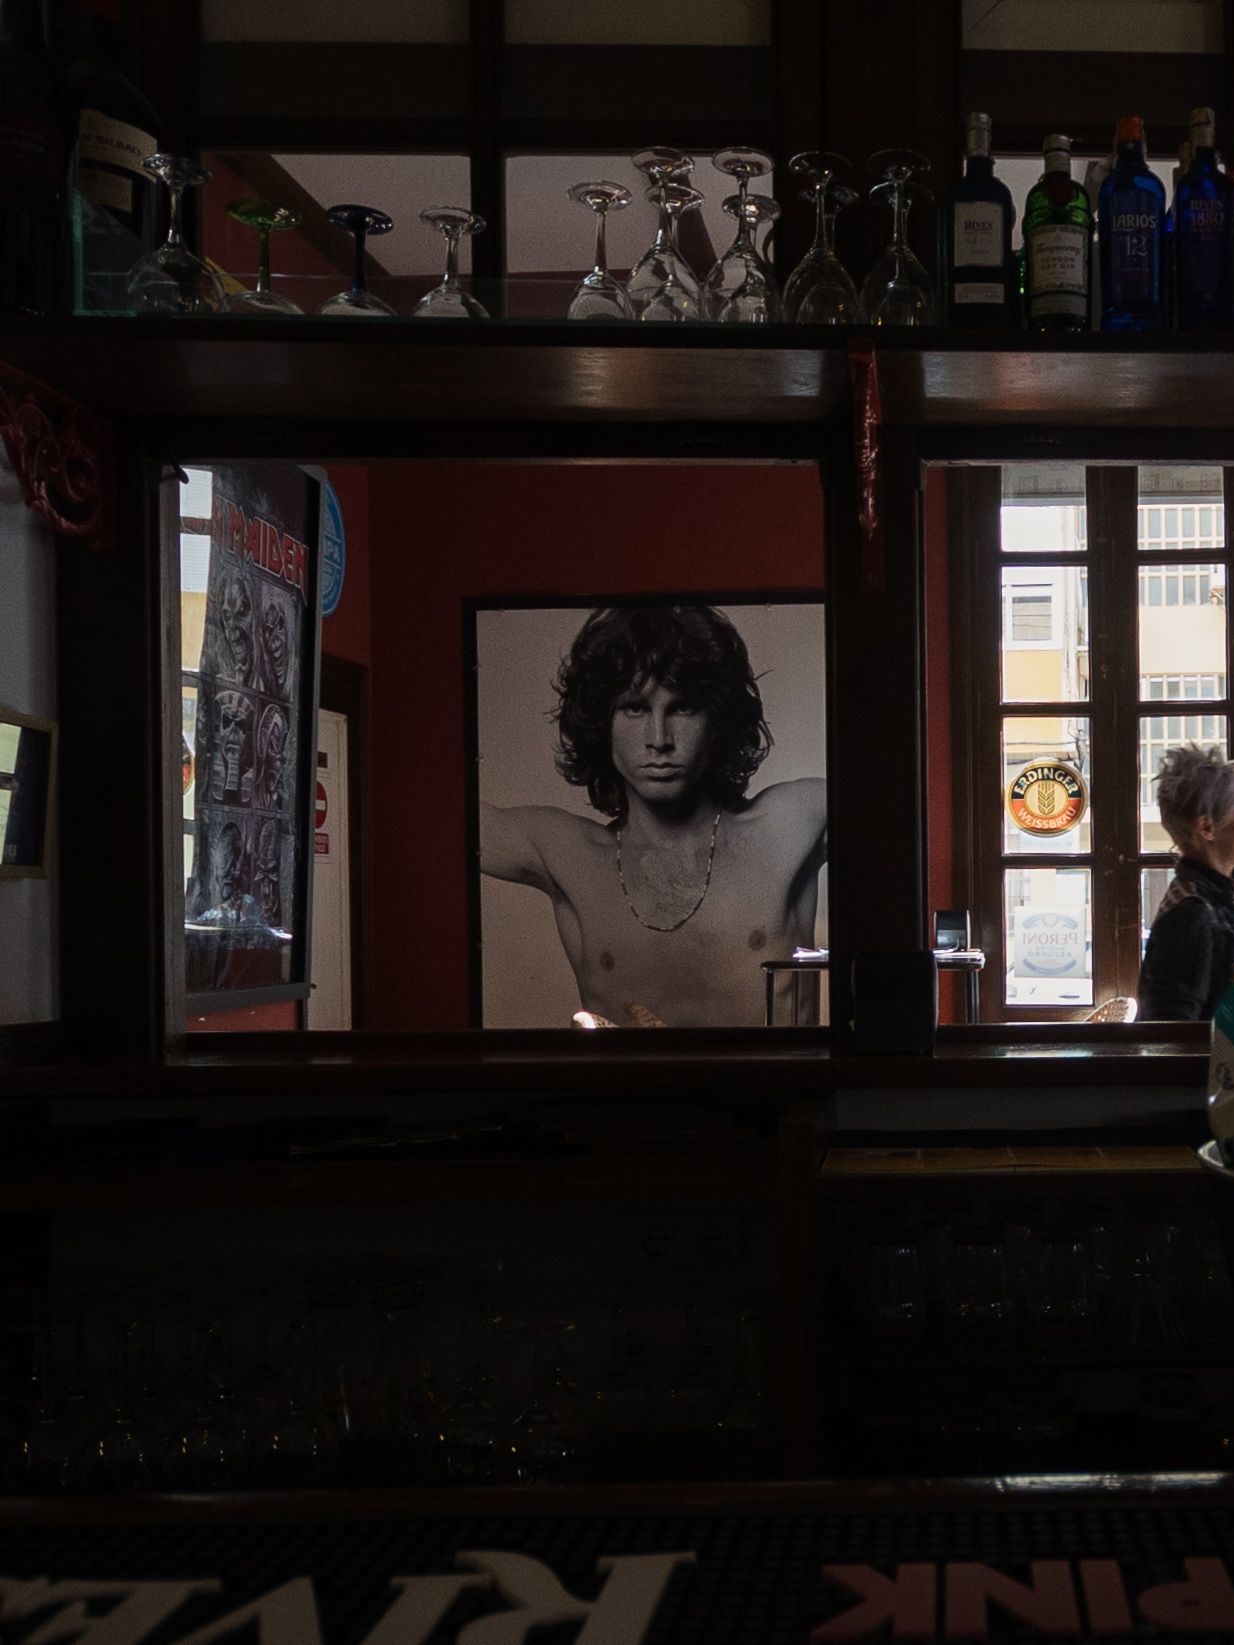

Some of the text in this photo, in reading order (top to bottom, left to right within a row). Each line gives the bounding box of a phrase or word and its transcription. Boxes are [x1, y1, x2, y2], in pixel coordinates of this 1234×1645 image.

[1112, 214, 1158, 231] LARIOS
[1120, 234, 1149, 257] 12
[226, 500, 310, 607] MAIDEN
[1014, 767, 1079, 795] ERDINGER
